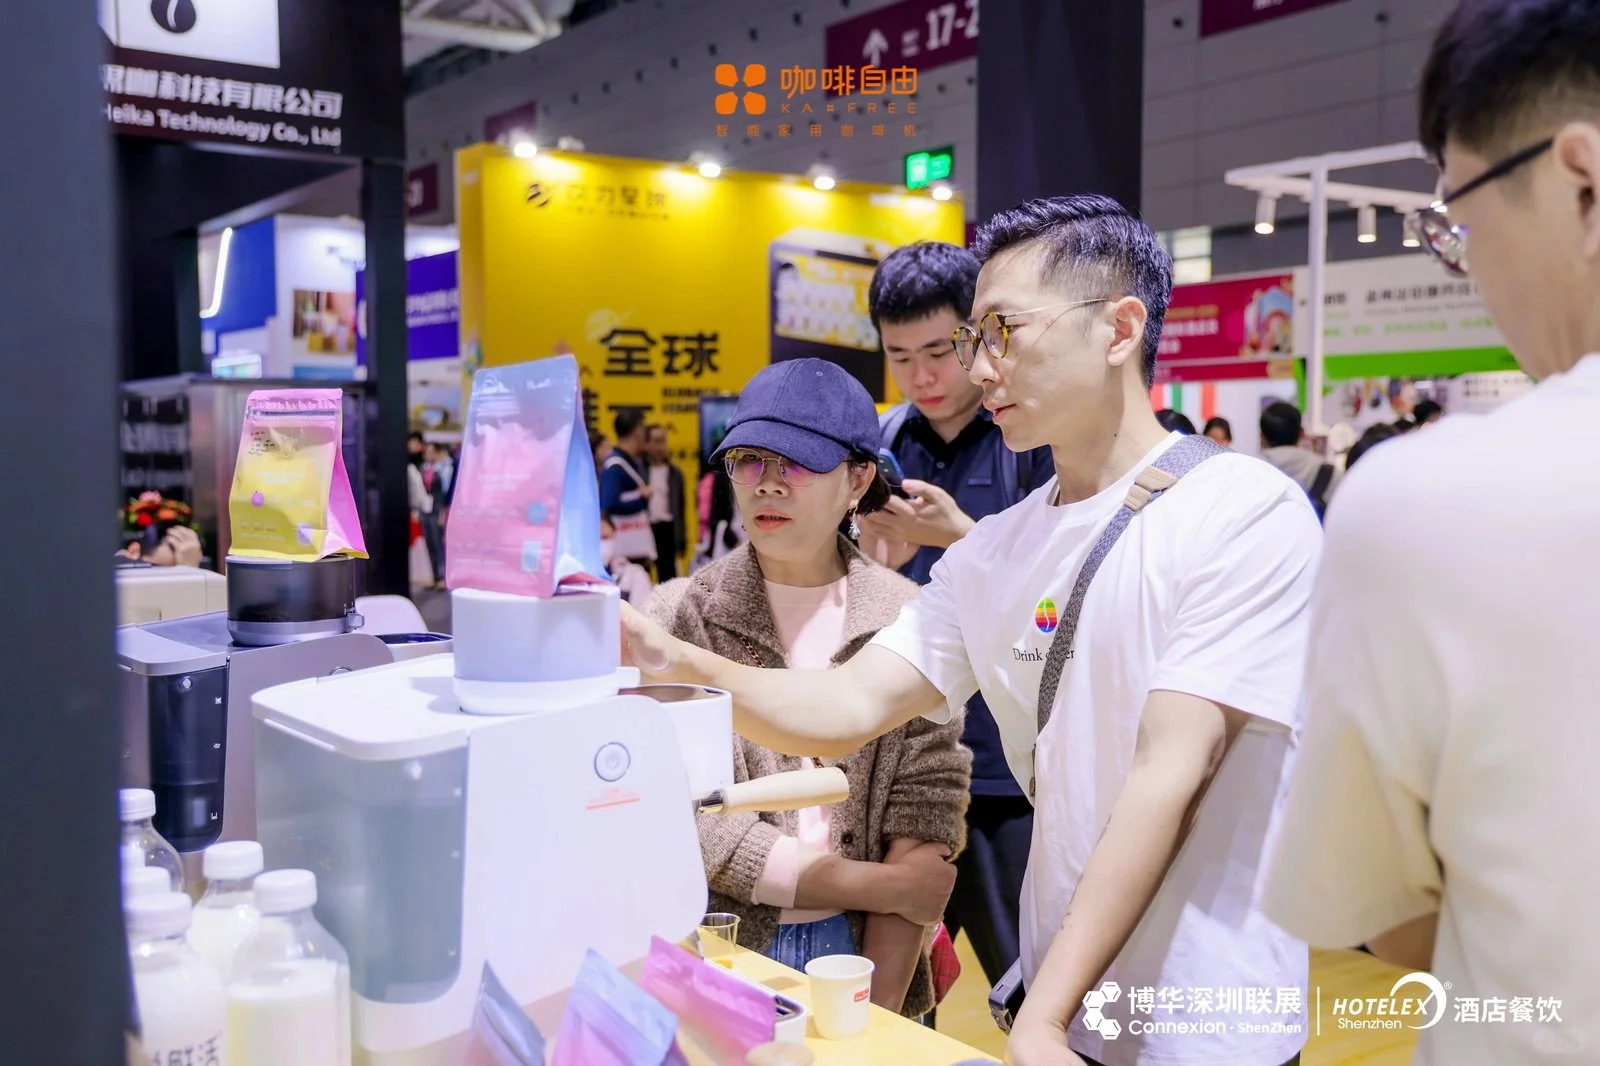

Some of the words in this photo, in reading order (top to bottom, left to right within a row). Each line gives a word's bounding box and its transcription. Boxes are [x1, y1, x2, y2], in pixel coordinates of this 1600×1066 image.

[157, 109, 271, 142] Technology
[311, 126, 342, 147] Ltd
[600, 329, 718, 377] 全球
[1012, 648, 1043, 662] Drink
